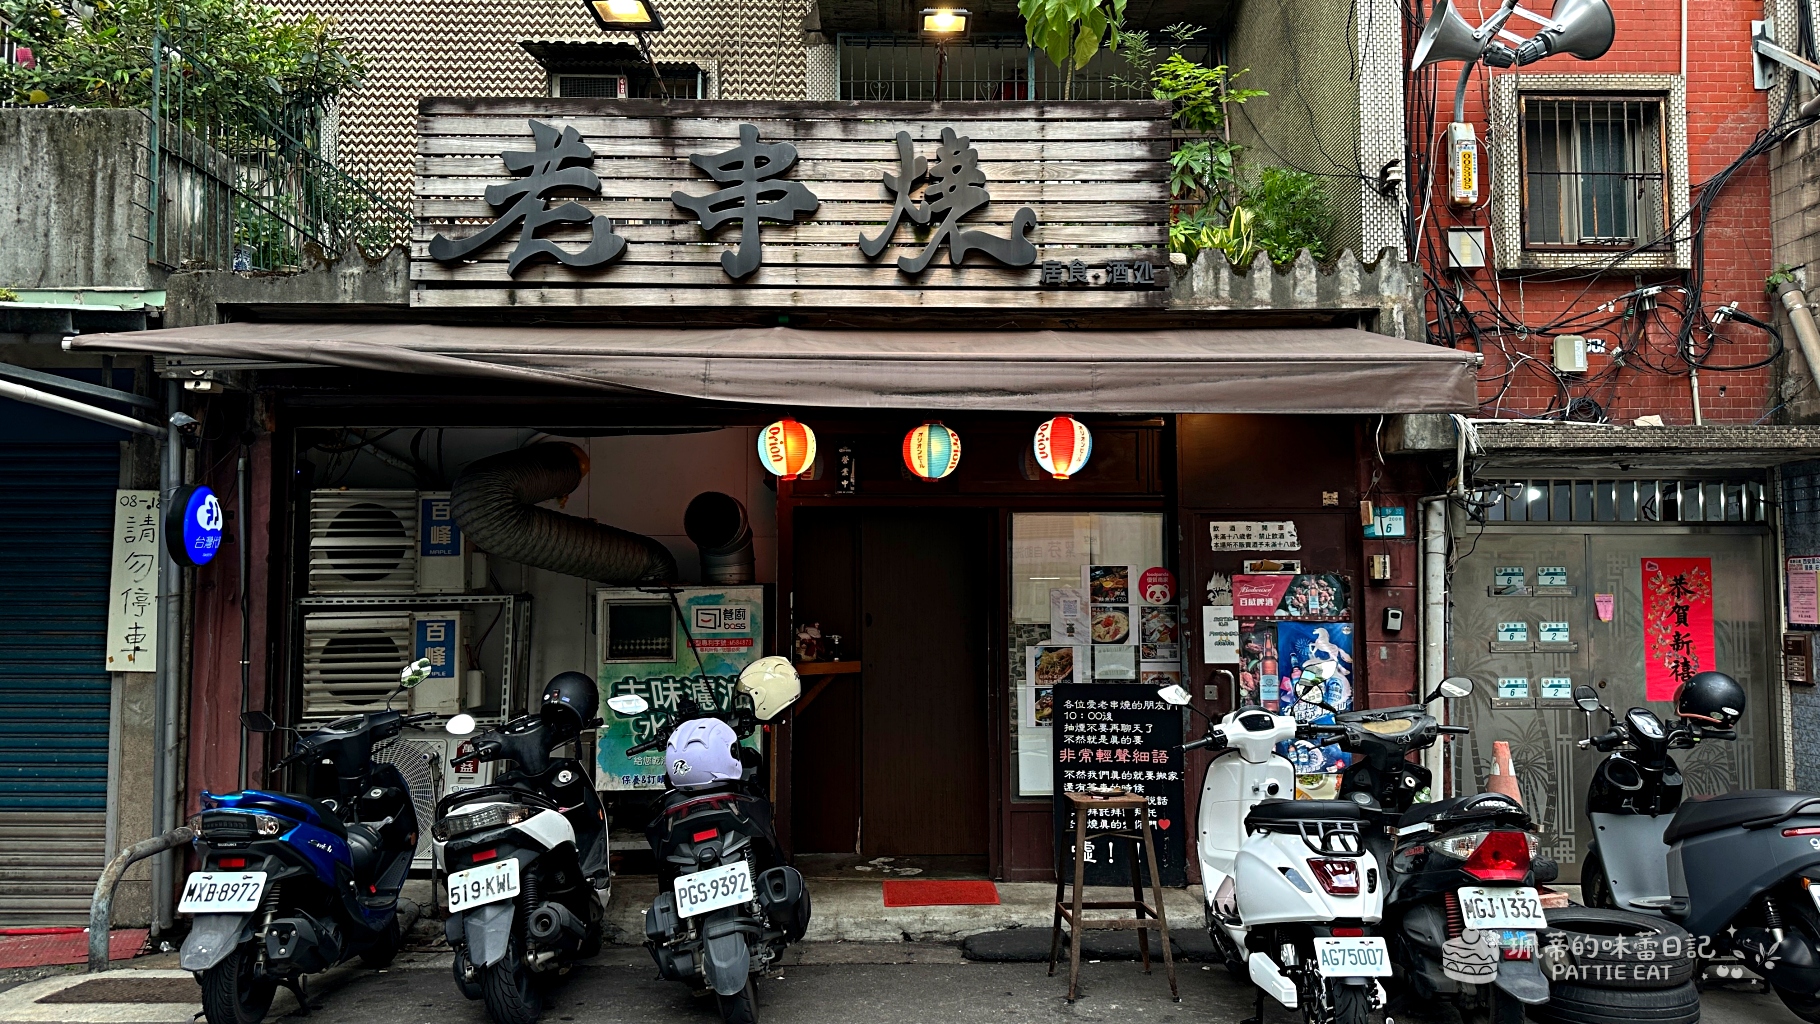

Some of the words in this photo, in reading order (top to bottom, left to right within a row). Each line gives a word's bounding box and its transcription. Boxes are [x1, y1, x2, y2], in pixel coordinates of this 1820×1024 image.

[429, 119, 1037, 279] 老串燒
[768, 426, 783, 463] Orion
[1037, 423, 1050, 460] Orion
[949, 431, 960, 470] Orion
[1386, 523, 1392, 534] 6
[1507, 576, 1512, 585] 6
[1549, 576, 1555, 585] 2
[120, 514, 156, 664] 請勿停車
[1239, 597, 1274, 607] 百威啤酒
[1668, 574, 1695, 683] 恭賀新禧
[1509, 632, 1515, 641] 6
[1551, 632, 1557, 641] 2
[1510, 688, 1515, 697] 6
[1553, 688, 1559, 697] 2
[1059, 748, 1170, 764] 非常輕聲細語
[1475, 800, 1508, 808] YMCO
[1321, 948, 1384, 966] AG75007
